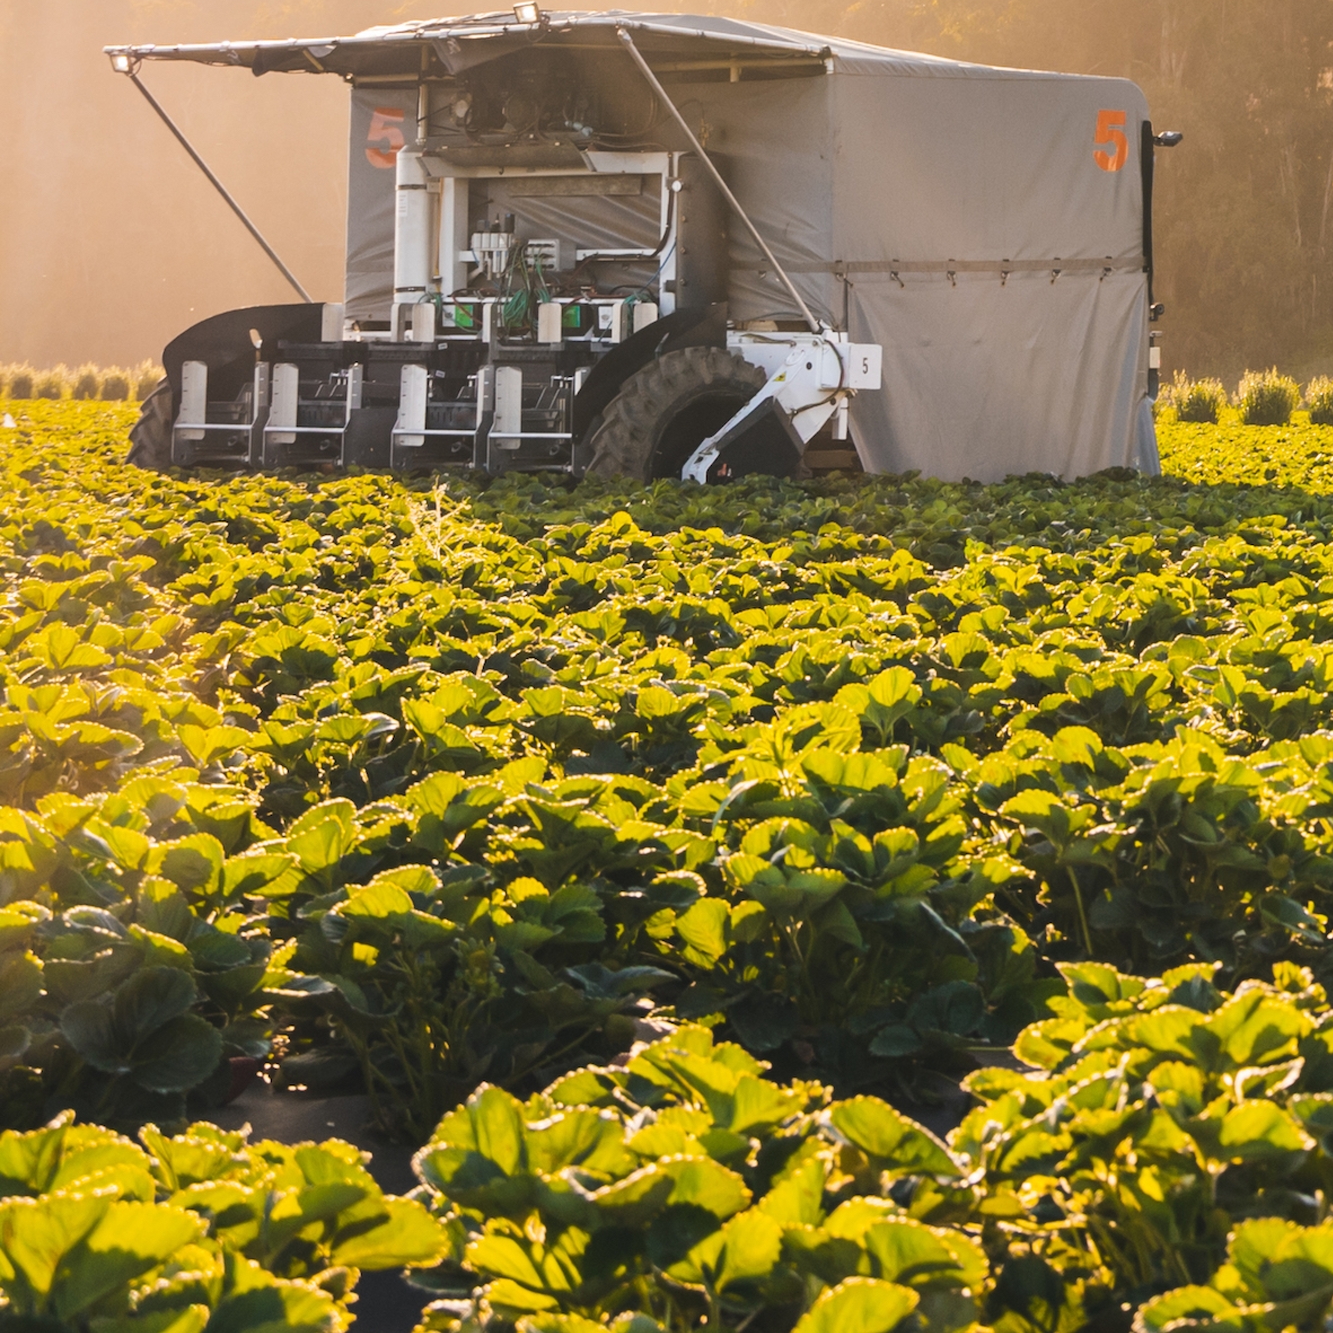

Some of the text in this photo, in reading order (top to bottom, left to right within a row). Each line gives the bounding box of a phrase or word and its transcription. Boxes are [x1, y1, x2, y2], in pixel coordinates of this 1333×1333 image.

[366, 108, 405, 169] 5
[1093, 109, 1129, 172] 5
[863, 357, 868, 374] 5
